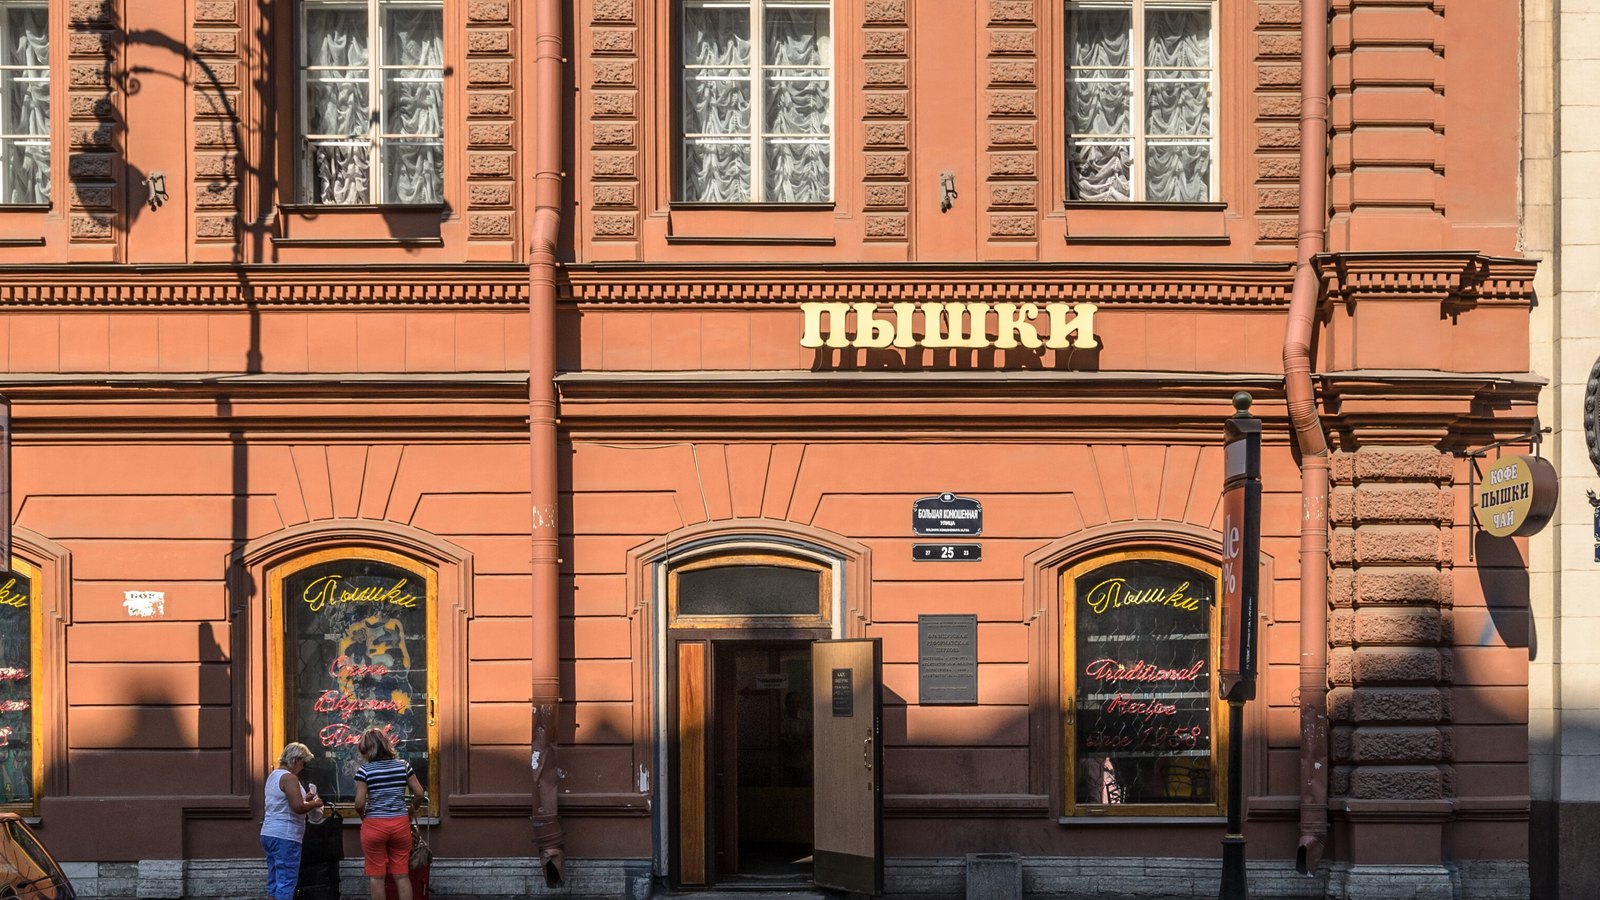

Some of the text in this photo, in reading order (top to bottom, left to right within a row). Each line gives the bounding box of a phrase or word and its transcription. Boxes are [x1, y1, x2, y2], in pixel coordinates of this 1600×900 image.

[800, 302, 1098, 349] ПЫШКИ
[1490, 464, 1518, 485] КОФЕ
[1481, 482, 1529, 508] ПЫШКИ
[918, 509, 978, 519] БОЛЬШАЯ КОНЮШЕННАЯ
[1493, 507, 1514, 529] ЧАЙ
[941, 547, 954, 558] 25
[1087, 578, 1199, 614] Пышки
[1086, 658, 1204, 684] Traditional
[1108, 693, 1177, 721] Recipe
